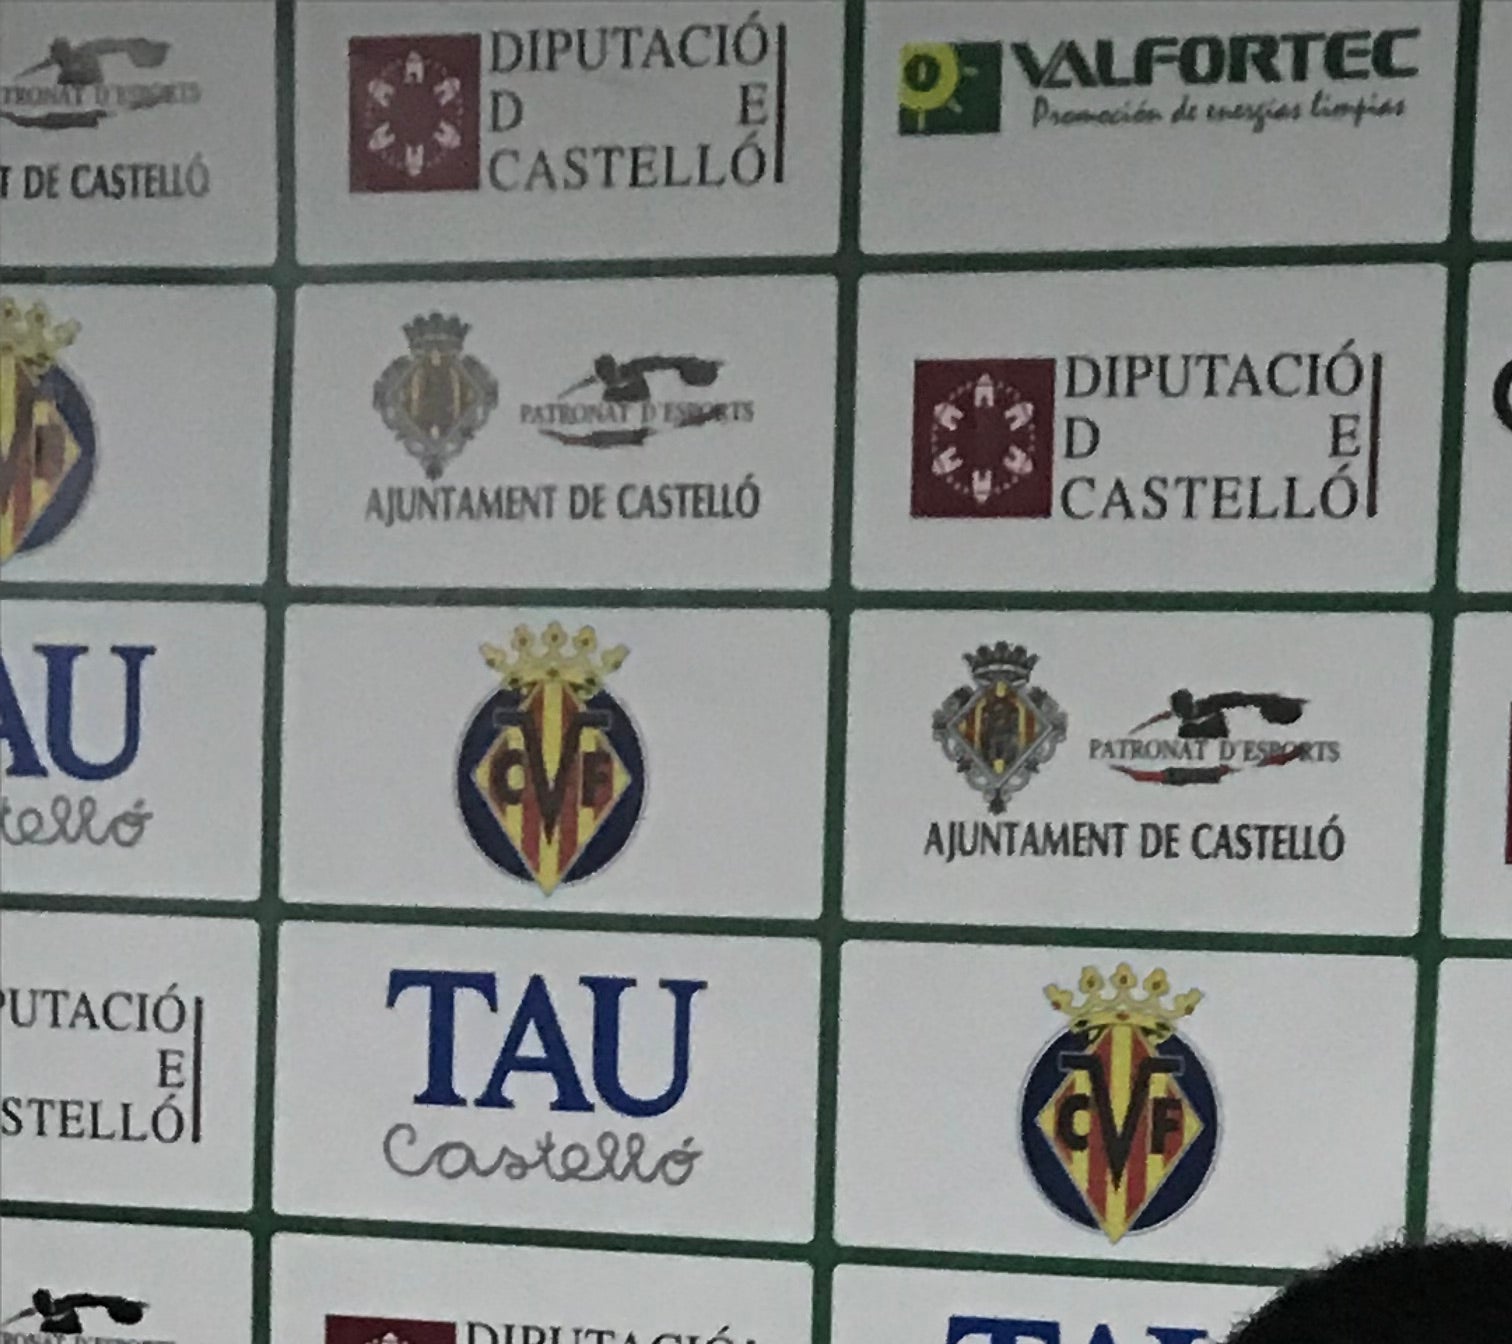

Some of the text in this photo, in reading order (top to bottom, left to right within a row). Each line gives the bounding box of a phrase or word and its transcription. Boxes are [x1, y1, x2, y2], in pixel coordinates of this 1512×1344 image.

[490, 10, 769, 73] DIPUTACIÓ
[1011, 28, 1420, 89] VALFORTEC
[491, 83, 767, 132] D E
[1171, 94, 1197, 124] de
[24, 165, 59, 199] DE
[71, 152, 209, 200] CASTELLÓ
[489, 130, 766, 191] CASTELLÓ
[1065, 339, 1363, 398] DIPUTACIÓ
[1065, 414, 1360, 459] D E
[366, 473, 760, 527] AJUNTAMENT DE CASTELLÓ
[1061, 463, 1358, 520] CASTELLÓ
[1090, 739, 1207, 760] PATRONAT
[924, 814, 1345, 863] AJUNTAMENT DE CASTELLÓ
[158, 1049, 184, 1088] E
[386, 969, 707, 1118] TAU
[383, 1123, 702, 1186] Castelló
